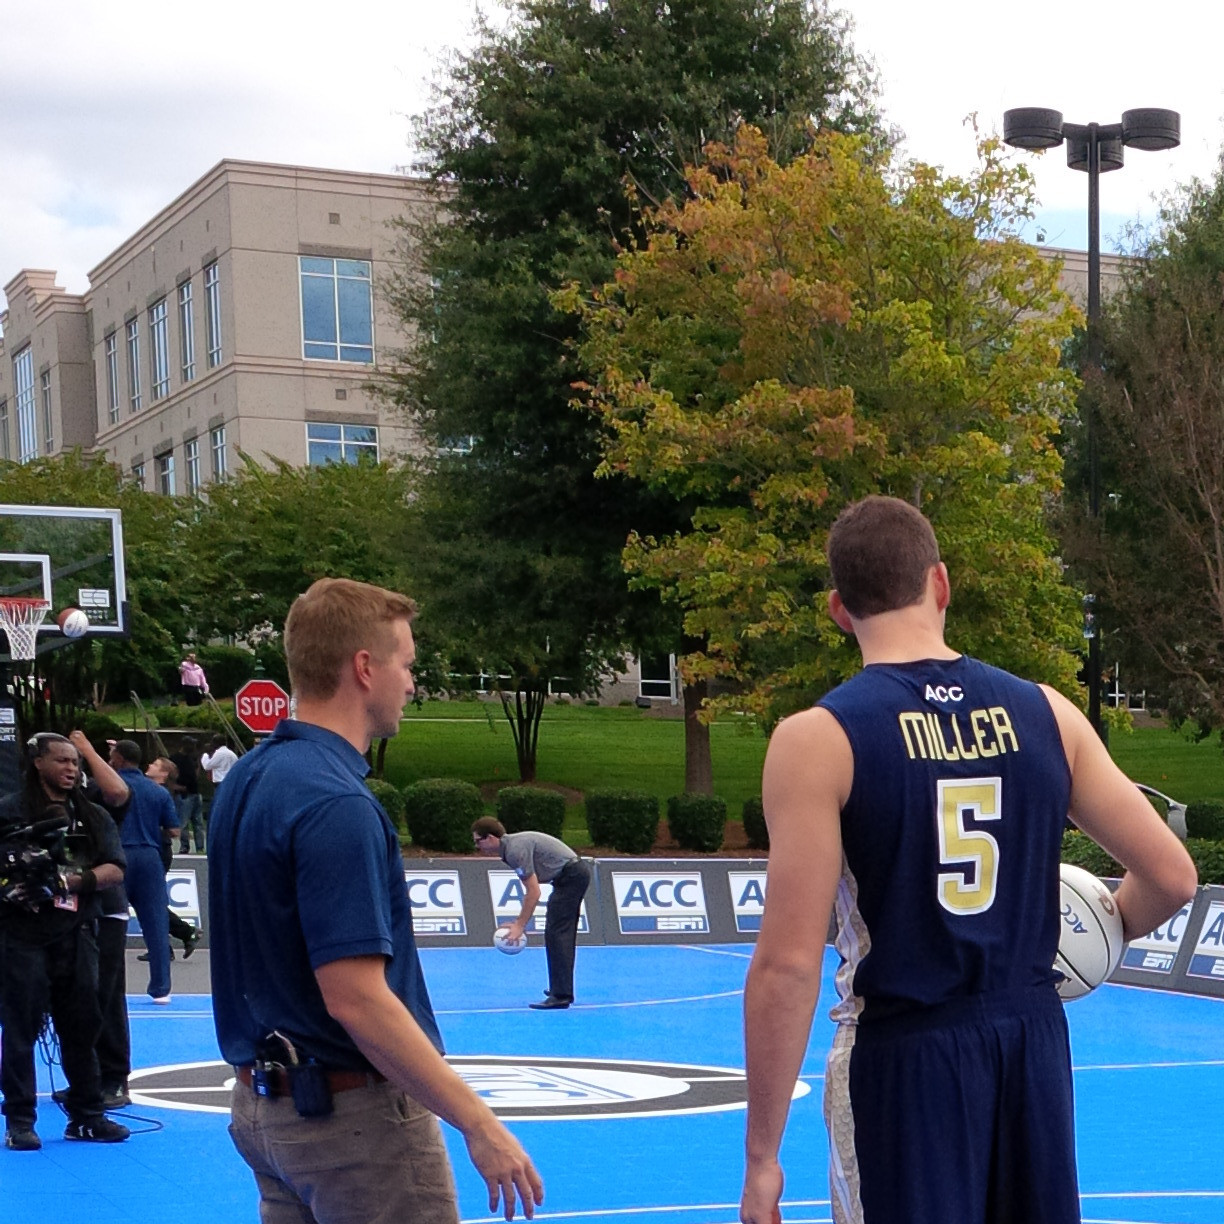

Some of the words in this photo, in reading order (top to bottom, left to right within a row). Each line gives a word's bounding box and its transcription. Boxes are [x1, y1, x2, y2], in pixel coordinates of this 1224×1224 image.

[925, 684, 964, 703] ACC
[240, 696, 286, 717] STOP
[898, 705, 1020, 761] MILLER
[936, 777, 1002, 915] 5
[406, 879, 455, 908] CC
[621, 879, 698, 908] ACC
[412, 919, 460, 932] ESPN
[656, 917, 703, 931] ESPN
[1142, 952, 1174, 970] ESPN
